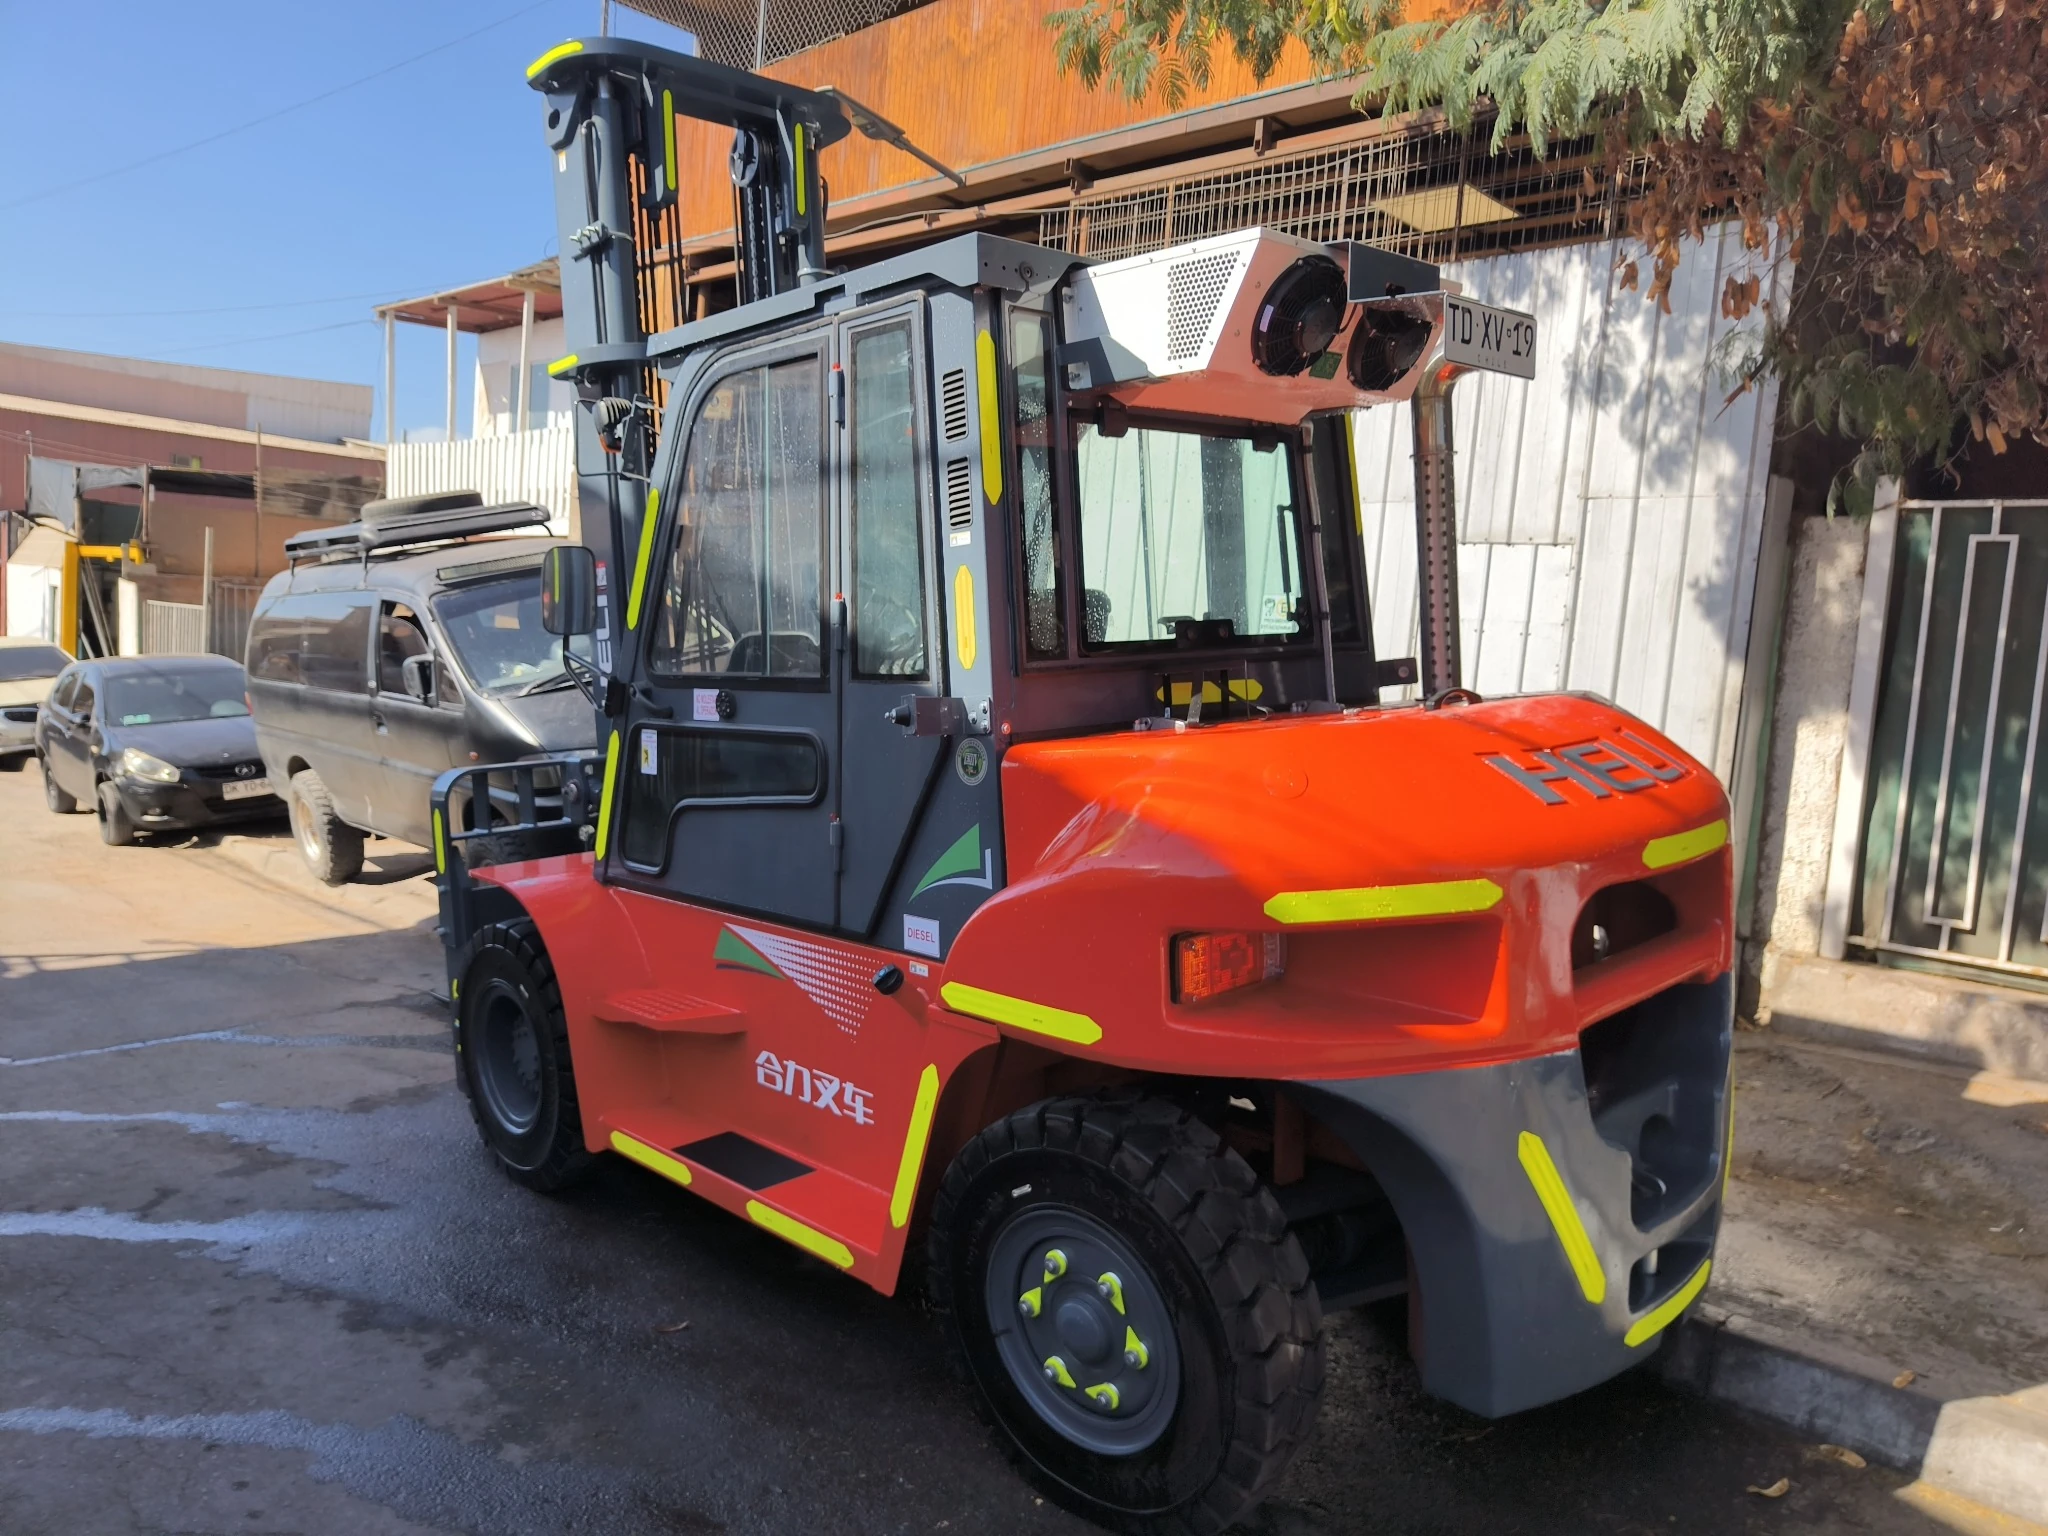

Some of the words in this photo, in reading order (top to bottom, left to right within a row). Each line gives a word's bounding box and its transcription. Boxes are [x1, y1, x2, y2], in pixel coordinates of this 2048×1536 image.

[907, 927, 935, 943] DIESEL
[755, 1050, 875, 1125] 合力叉车
